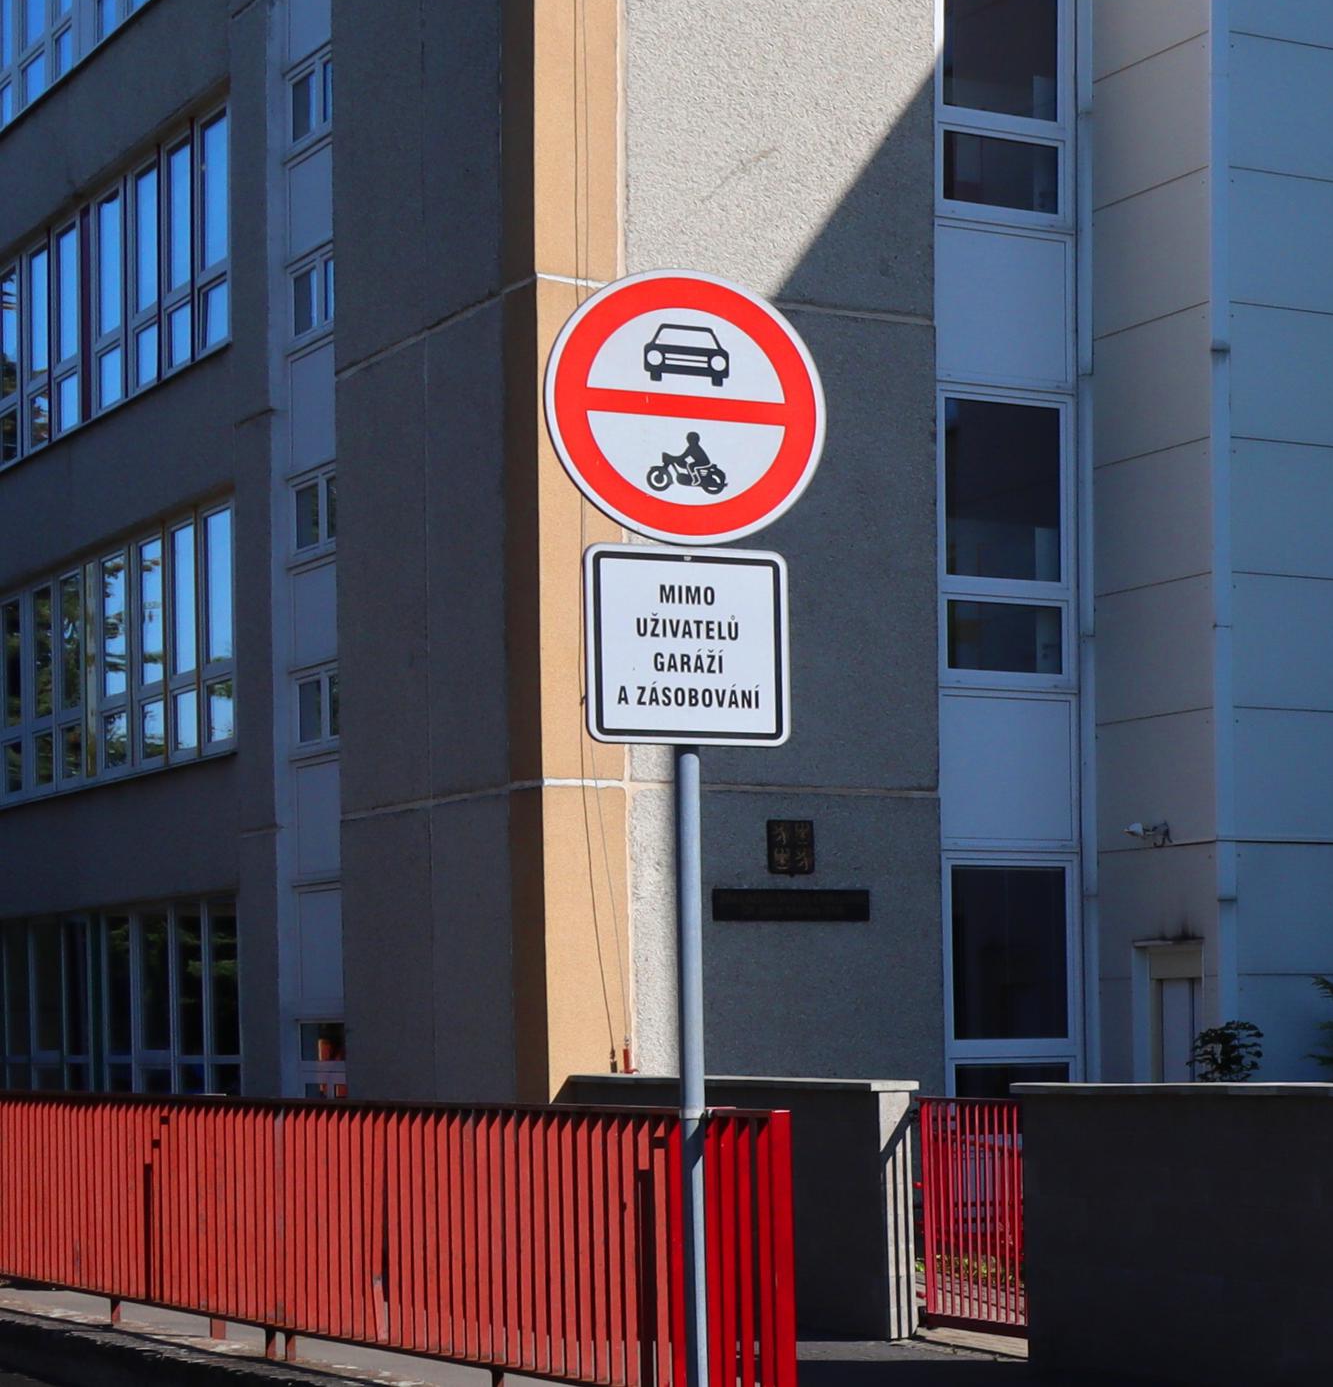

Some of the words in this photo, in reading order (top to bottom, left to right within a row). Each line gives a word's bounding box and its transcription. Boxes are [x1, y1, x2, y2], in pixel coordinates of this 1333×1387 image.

[659, 583, 716, 607] MIMO
[636, 611, 739, 642] UŽIVATELŮ
[653, 647, 724, 674] GARÁŽÍ
[617, 685, 630, 705] A
[636, 680, 760, 710] ZÁSOBOVÁNÍ
